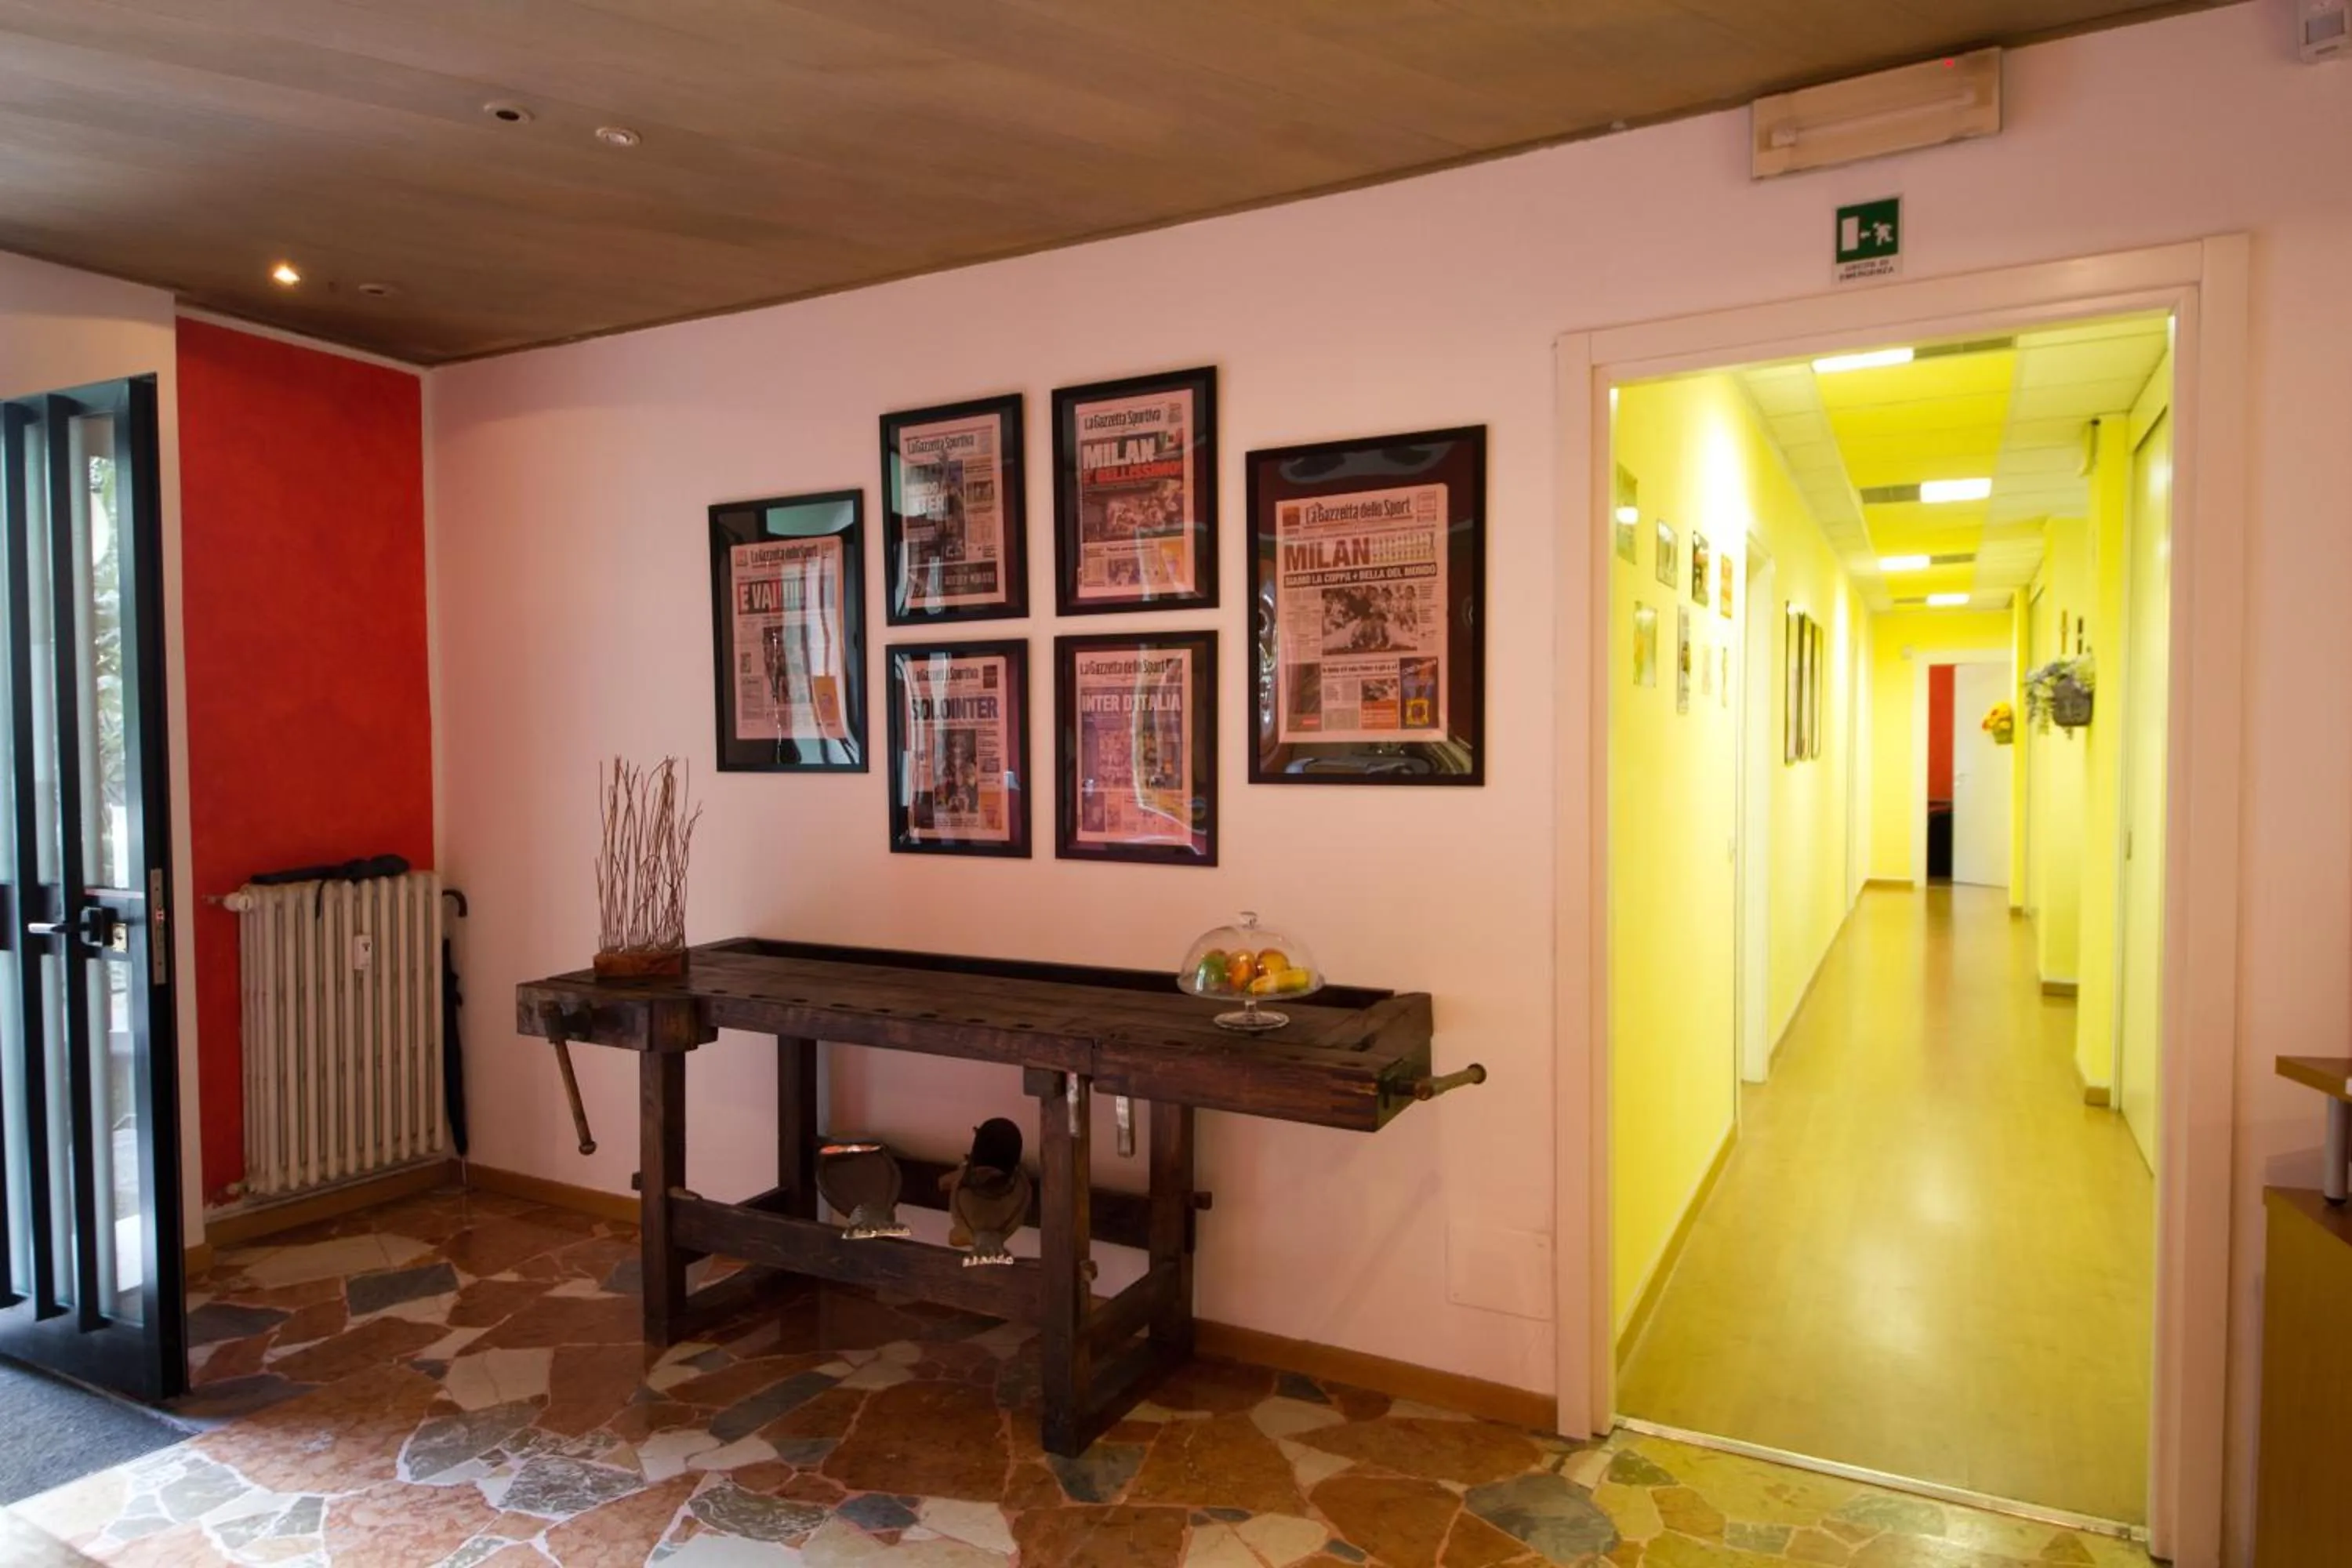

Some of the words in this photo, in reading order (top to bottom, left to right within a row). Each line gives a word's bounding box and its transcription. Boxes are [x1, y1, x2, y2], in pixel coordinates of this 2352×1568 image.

[1094, 414, 1127, 428] Gazzetta
[1127, 409, 1161, 427] Sportiva
[1083, 437, 1156, 470] MILAN
[1318, 501, 1359, 522] Gazzetta
[1384, 496, 1410, 517] Sport
[1284, 537, 1370, 572] MILAN
[1312, 574, 1322, 583] LA
[950, 695, 999, 719] INTER
[1082, 694, 1120, 712] INTER
